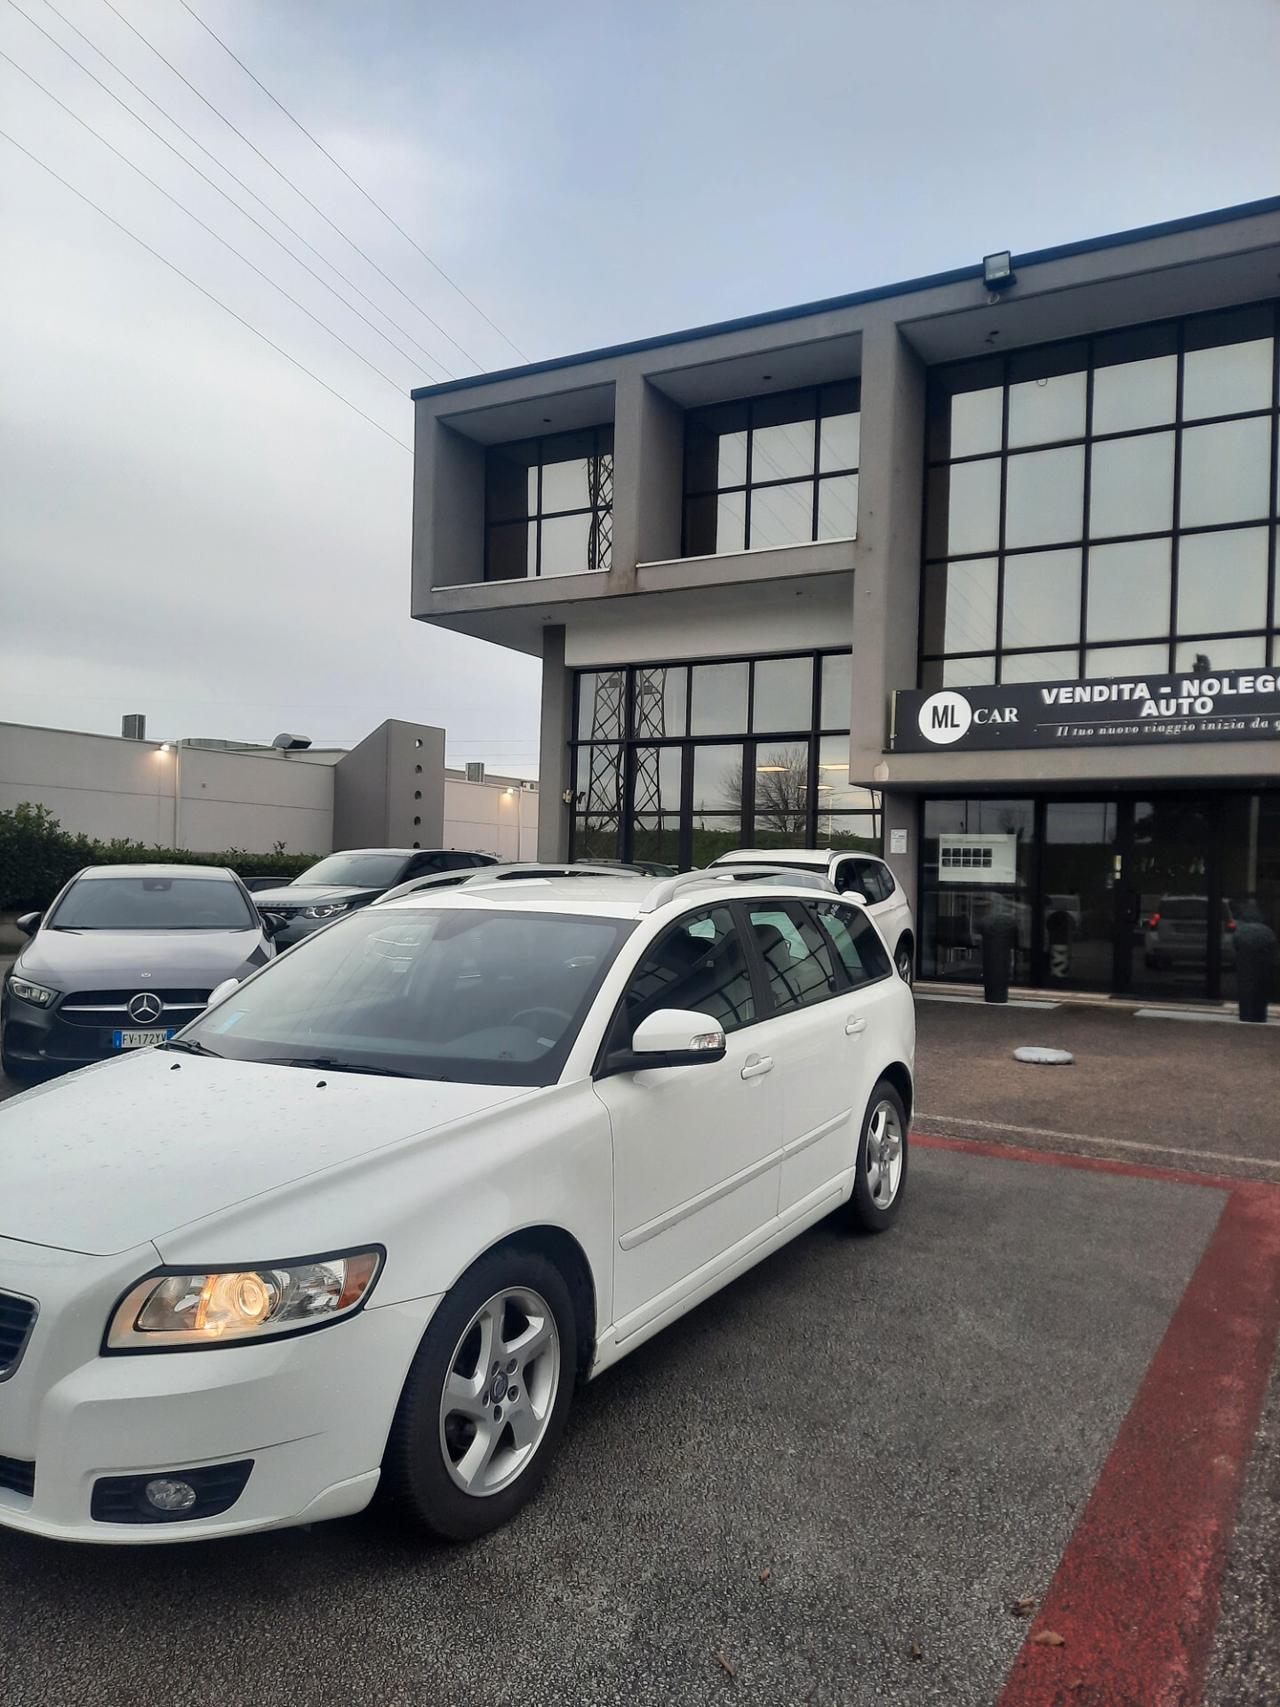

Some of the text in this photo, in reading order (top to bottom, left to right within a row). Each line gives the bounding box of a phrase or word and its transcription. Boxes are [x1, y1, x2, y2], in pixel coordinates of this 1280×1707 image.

[1041, 683, 1151, 704] VENDITA
[1181, 674, 1280, 697] NOLEG
[931, 704, 1019, 729] ML CAR
[1139, 697, 1214, 717] AUTO
[1056, 725, 1069, 737] Il
[1073, 726, 1094, 736] tuo
[1099, 725, 1139, 735] nuovo
[1144, 721, 1196, 735] viaggio
[1201, 718, 1246, 731] inizia
[1251, 717, 1269, 729] da
